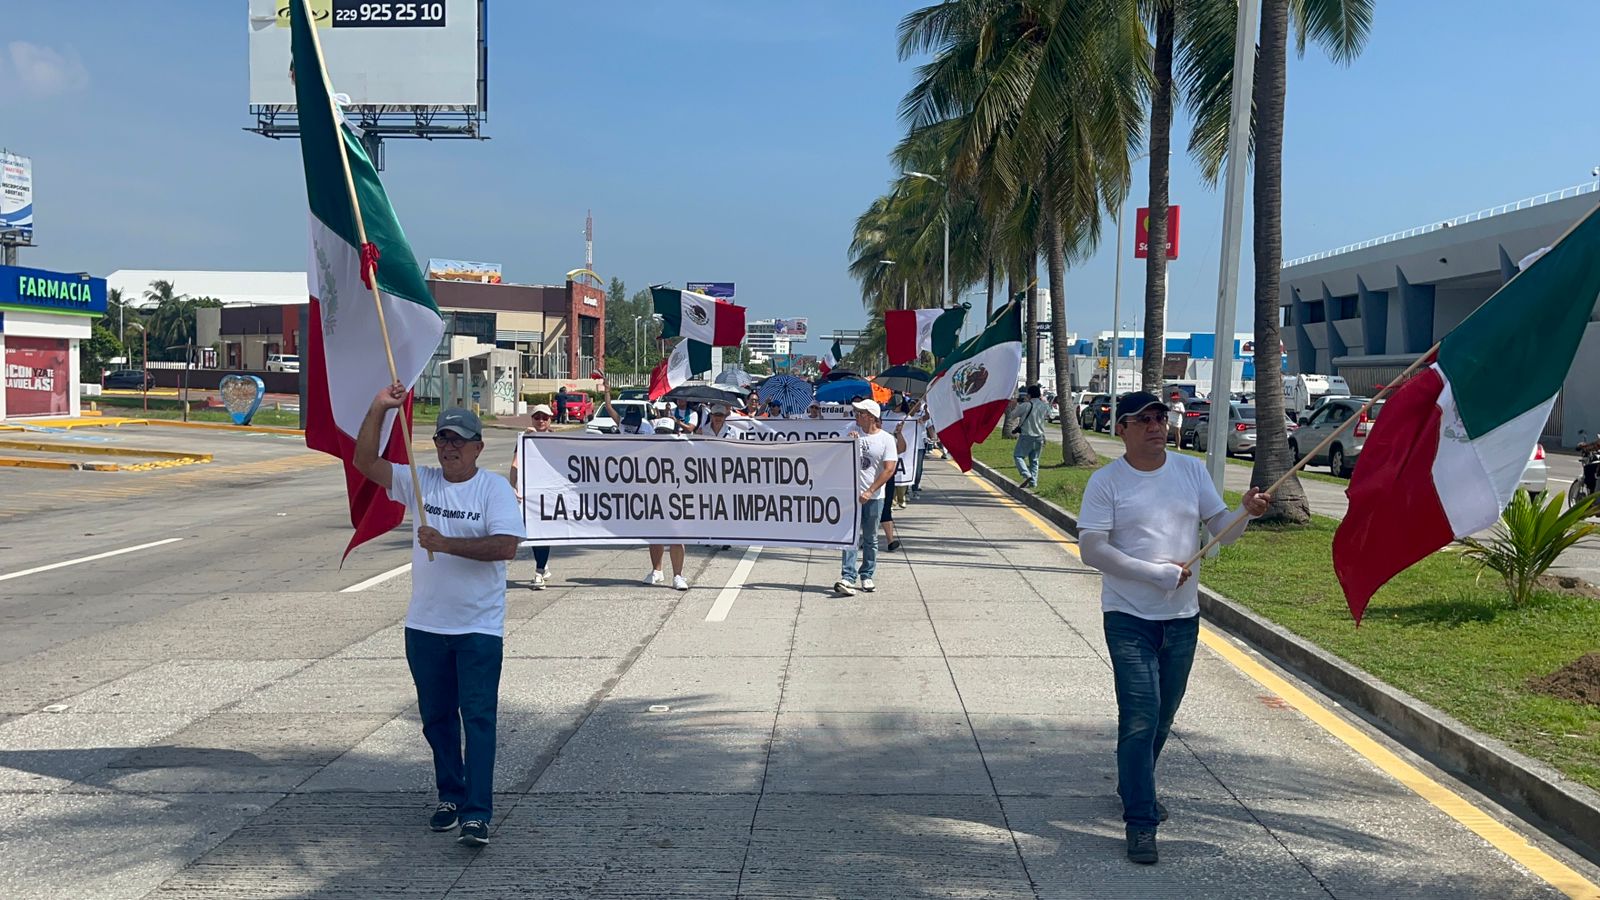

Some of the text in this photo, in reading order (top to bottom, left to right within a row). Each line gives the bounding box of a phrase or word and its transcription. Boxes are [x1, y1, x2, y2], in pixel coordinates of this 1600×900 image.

[336, 10, 358, 21] 229
[360, 3, 392, 21] 925
[395, 3, 417, 21] 25
[420, 3, 443, 21] 10
[19, 276, 92, 302] FARMACIA
[567, 455, 813, 490] SIN COLOR, SIN PARTIDO,
[467, 511, 481, 521] PJF
[540, 493, 841, 525] LA JUSTICIA SE HA IMPARTIDO
